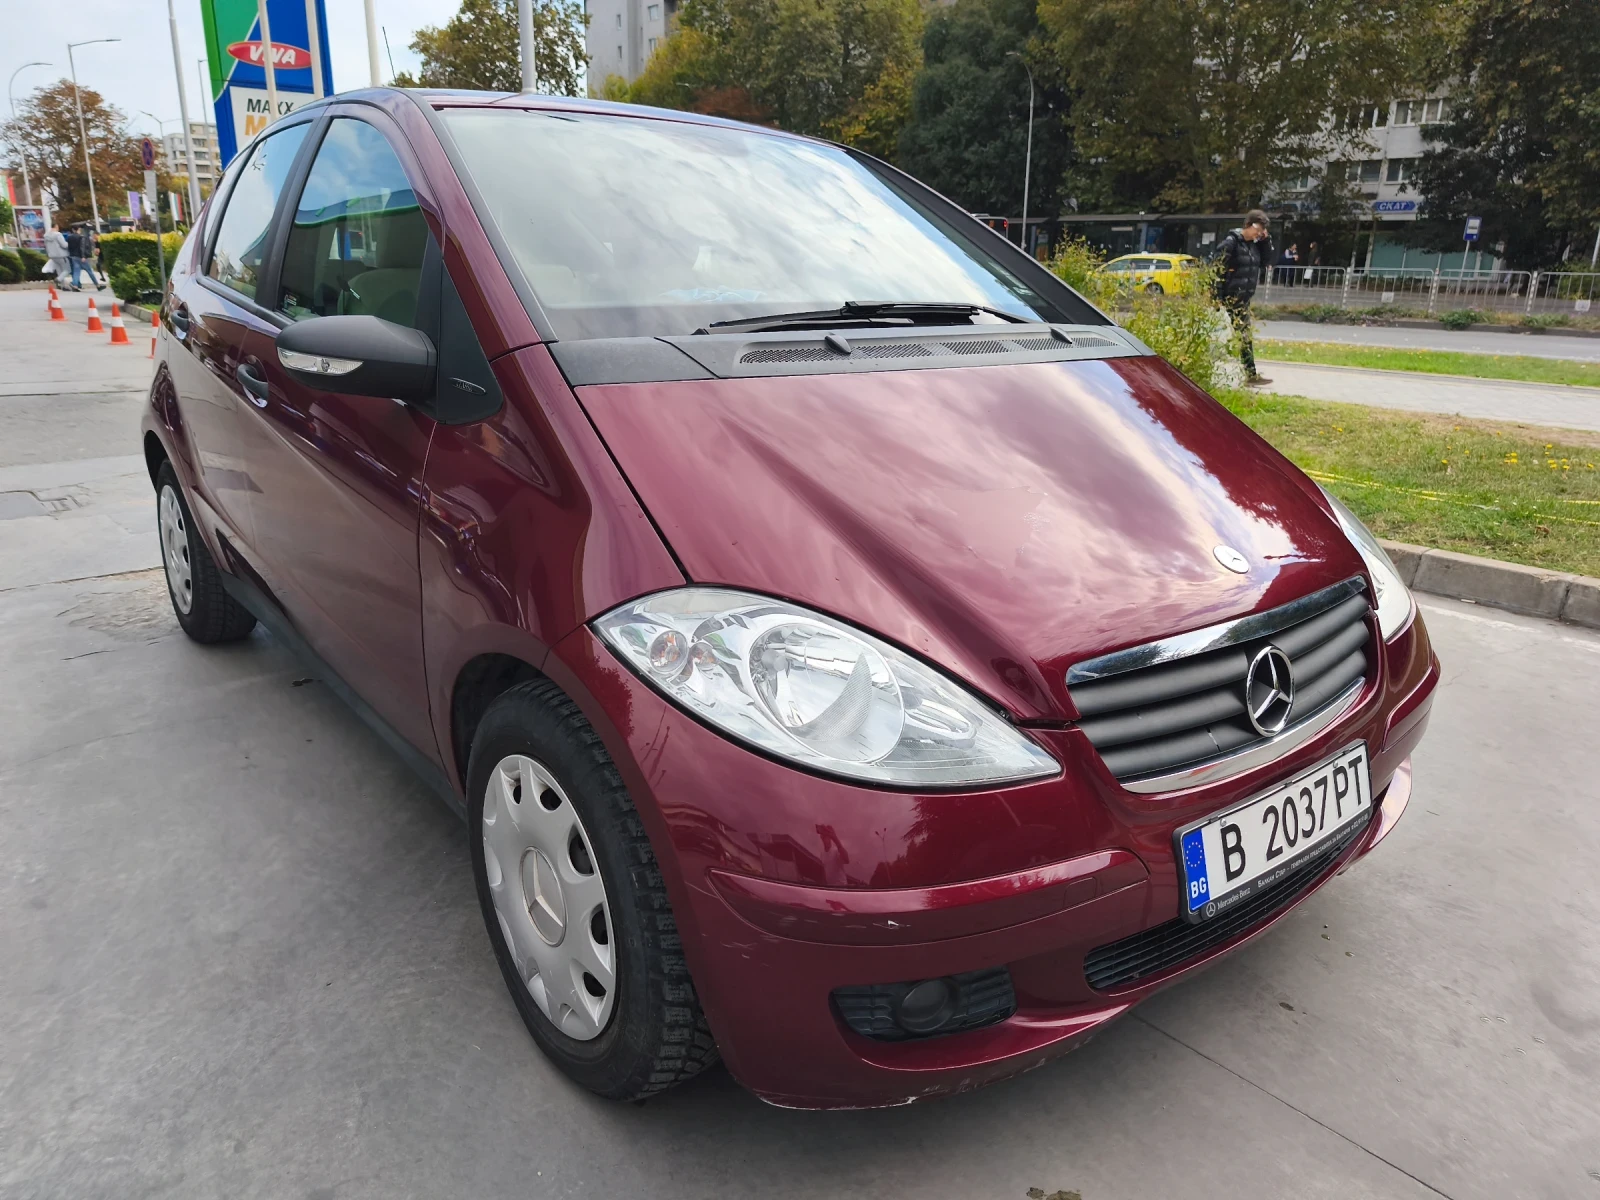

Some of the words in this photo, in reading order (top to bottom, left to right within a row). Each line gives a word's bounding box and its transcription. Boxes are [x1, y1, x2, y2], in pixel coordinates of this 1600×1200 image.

[249, 45, 296, 65] VVA
[1221, 822, 1247, 882] B
[1190, 876, 1207, 898] BG
